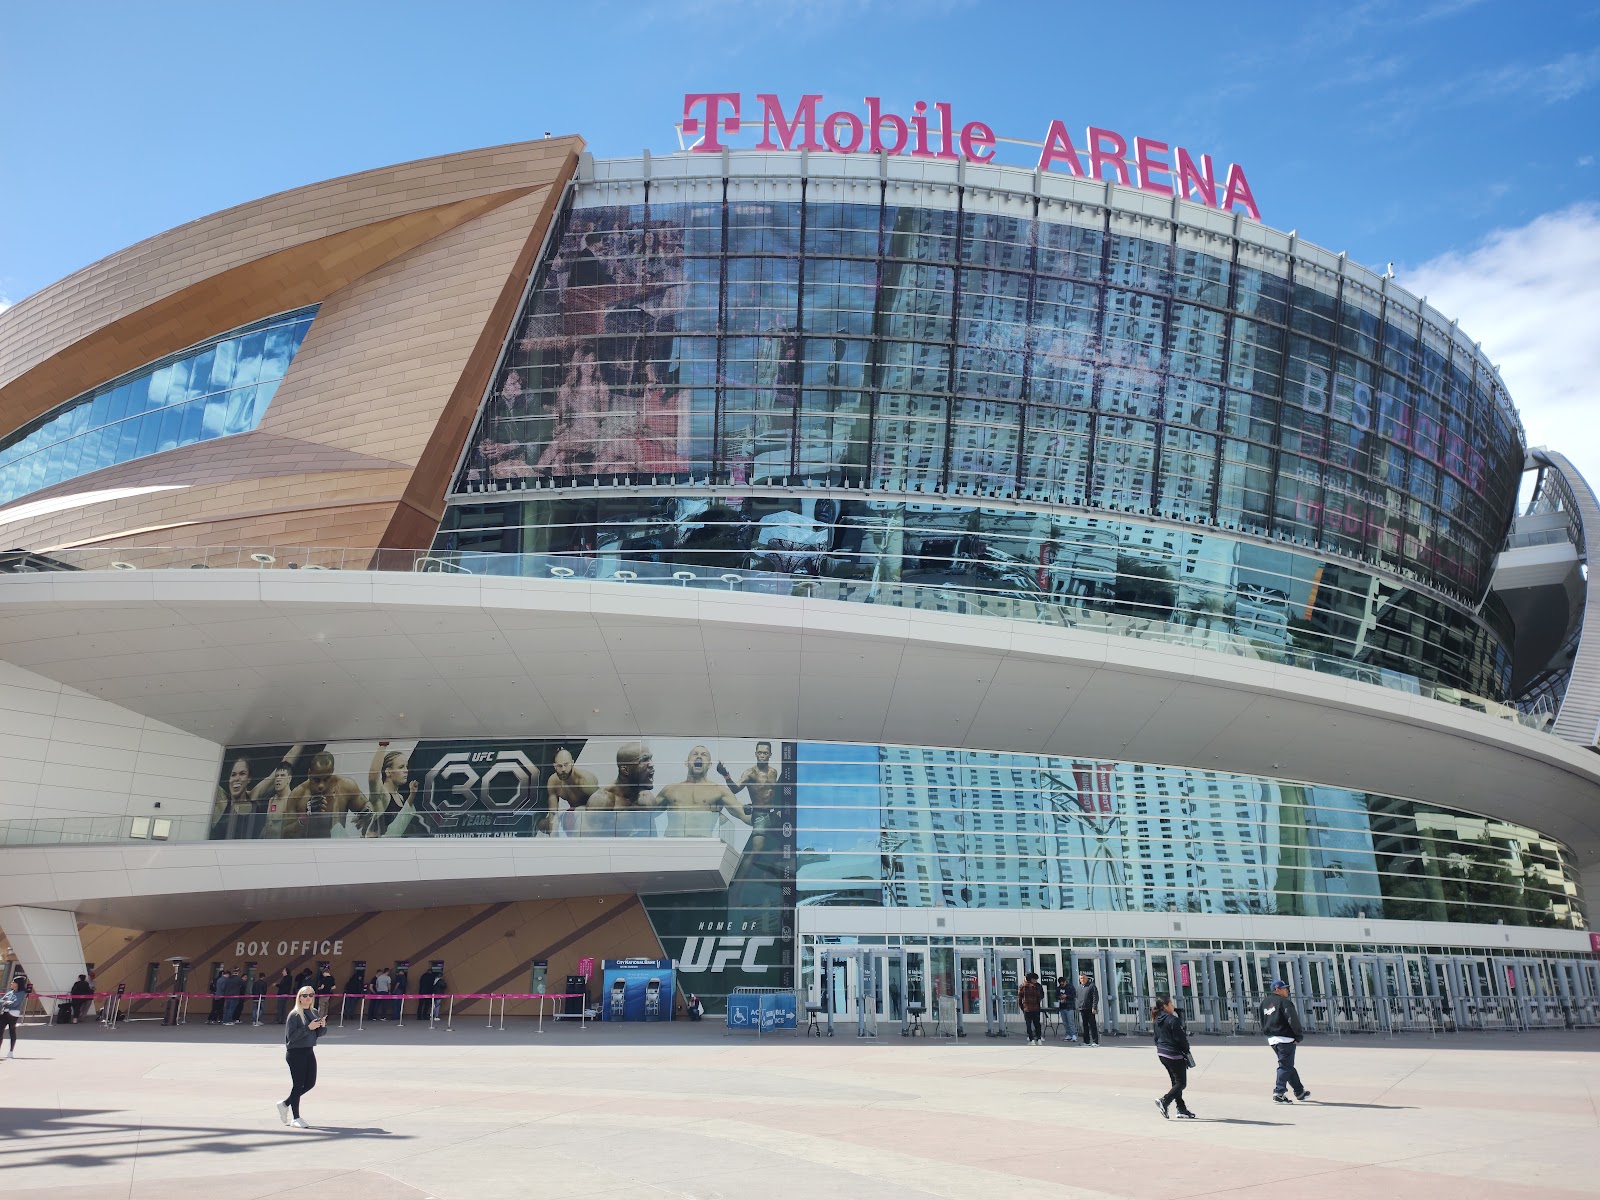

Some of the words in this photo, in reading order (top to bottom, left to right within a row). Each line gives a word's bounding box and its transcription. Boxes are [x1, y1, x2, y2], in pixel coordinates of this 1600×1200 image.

[755, 93, 997, 165] Mobile
[1037, 118, 1262, 221] ARENA
[471, 751, 495, 762] UFC
[437, 762, 532, 817] 30
[461, 815, 492, 826] YEARS
[698, 921, 733, 931] HOME
[742, 921, 758, 931] OF
[235, 941, 270, 957] BOX
[277, 940, 344, 956] OFFICE
[680, 936, 776, 973] UFC
